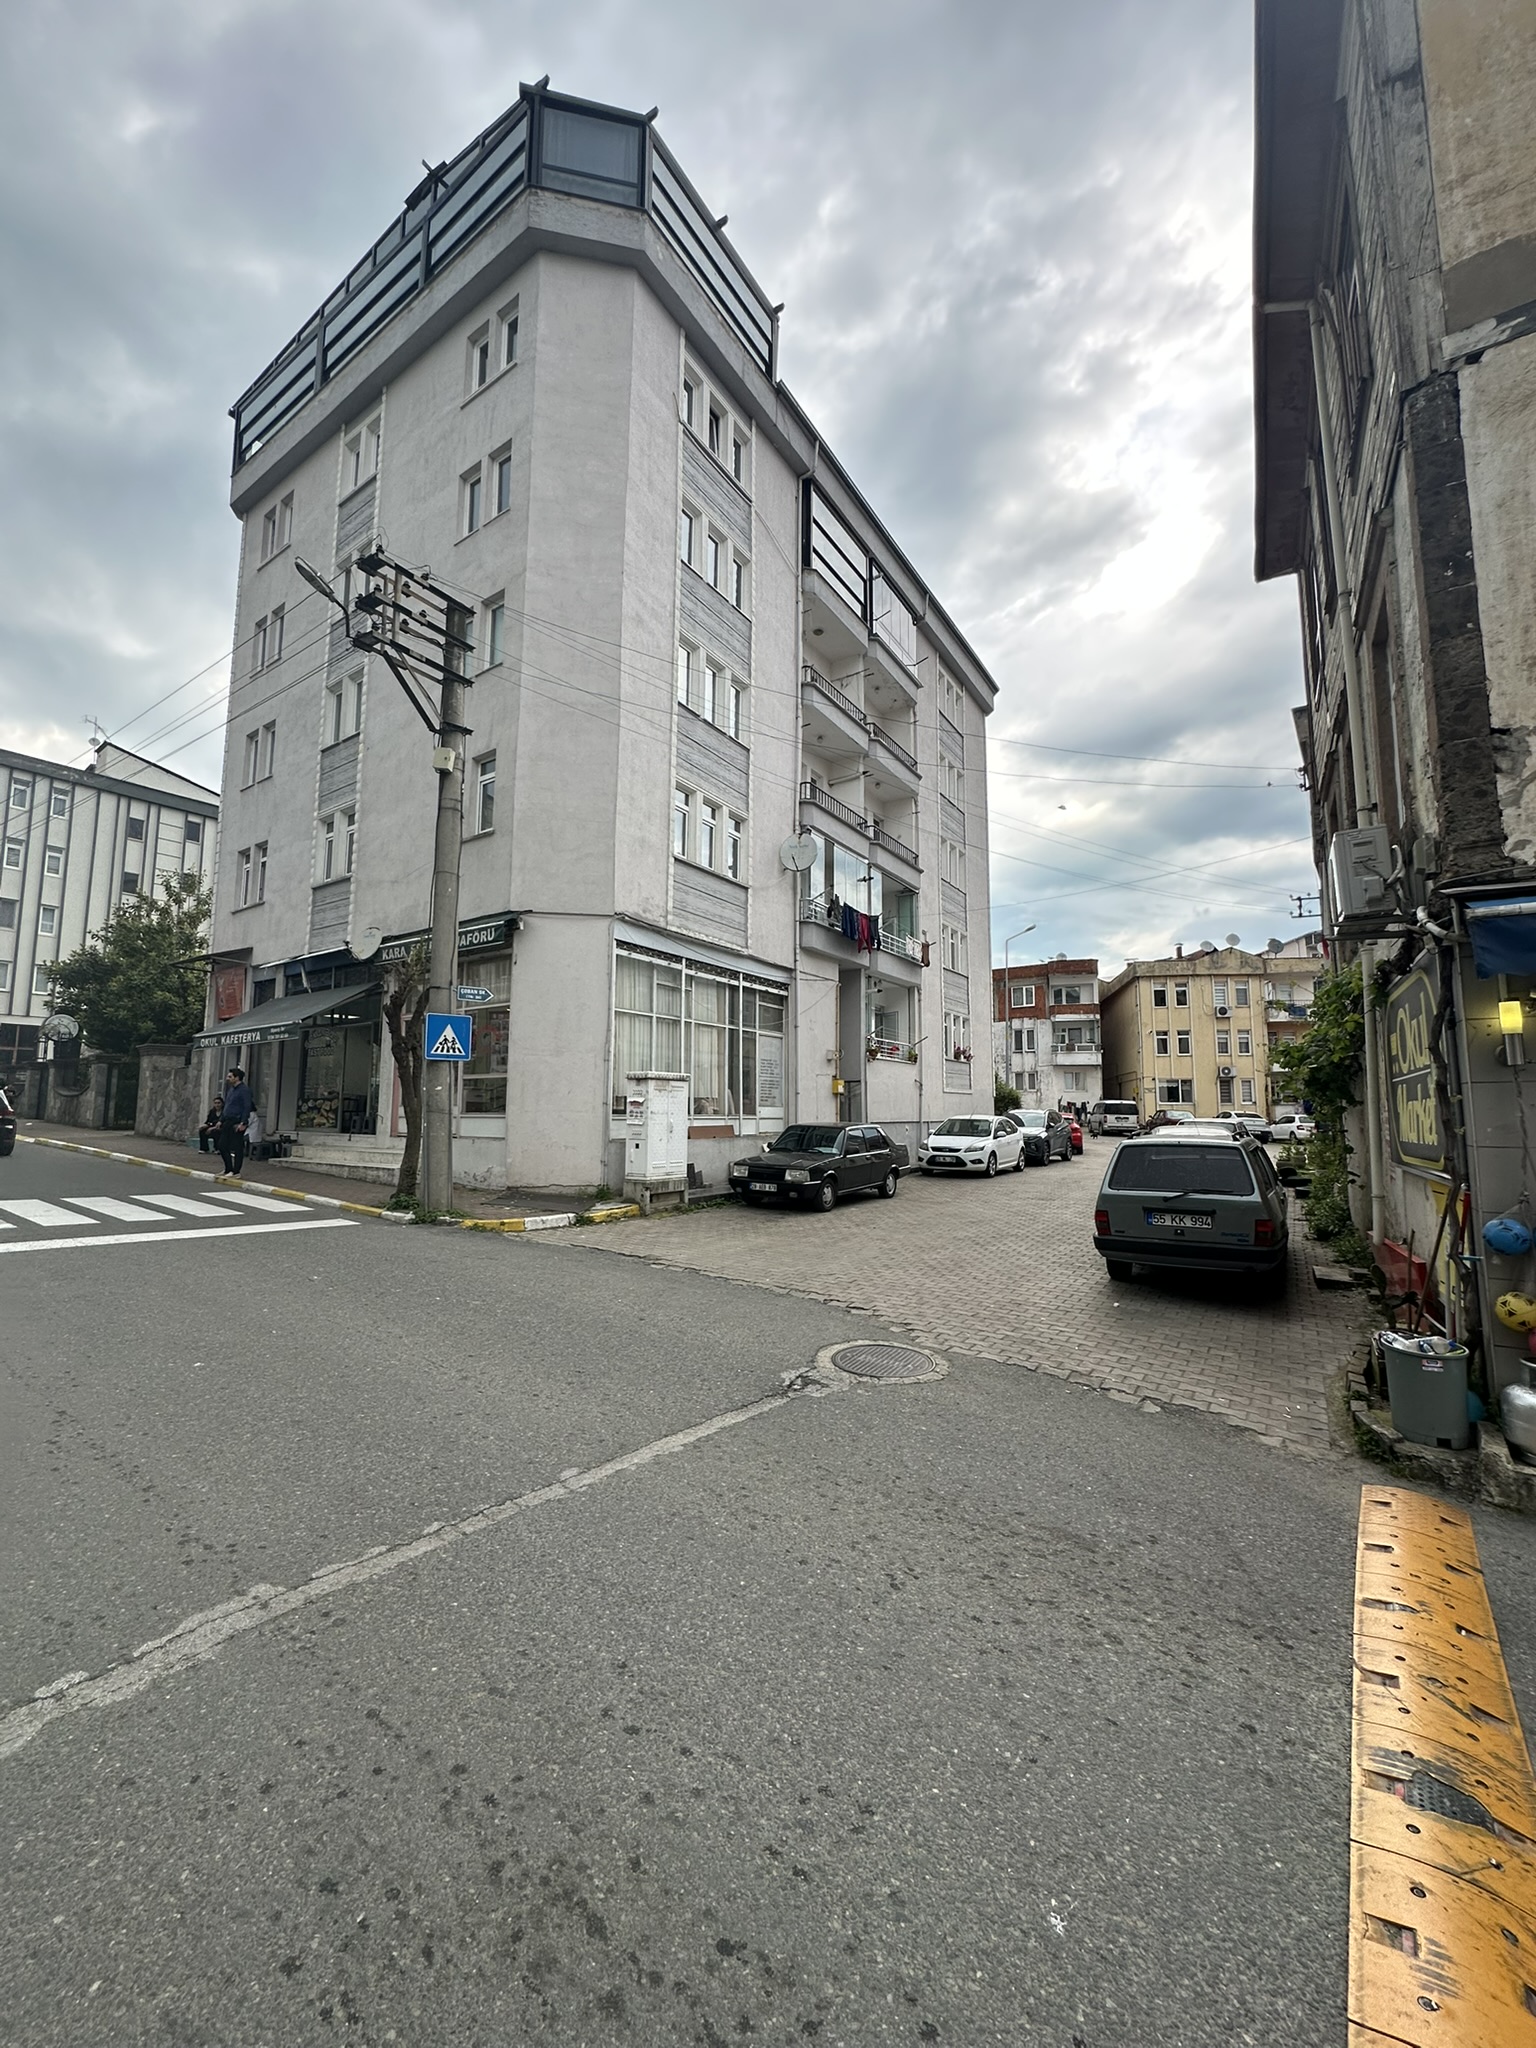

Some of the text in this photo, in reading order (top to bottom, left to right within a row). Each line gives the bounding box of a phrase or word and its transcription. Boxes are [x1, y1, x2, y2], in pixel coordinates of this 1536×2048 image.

[382, 946, 407, 960] KARA
[201, 1036, 219, 1047] OKUL
[221, 1031, 261, 1045] KAFETERYA
[1396, 991, 1431, 1074] Okul
[1397, 1082, 1438, 1146] Market
[1153, 1213, 1211, 1227] 55 KK 994
